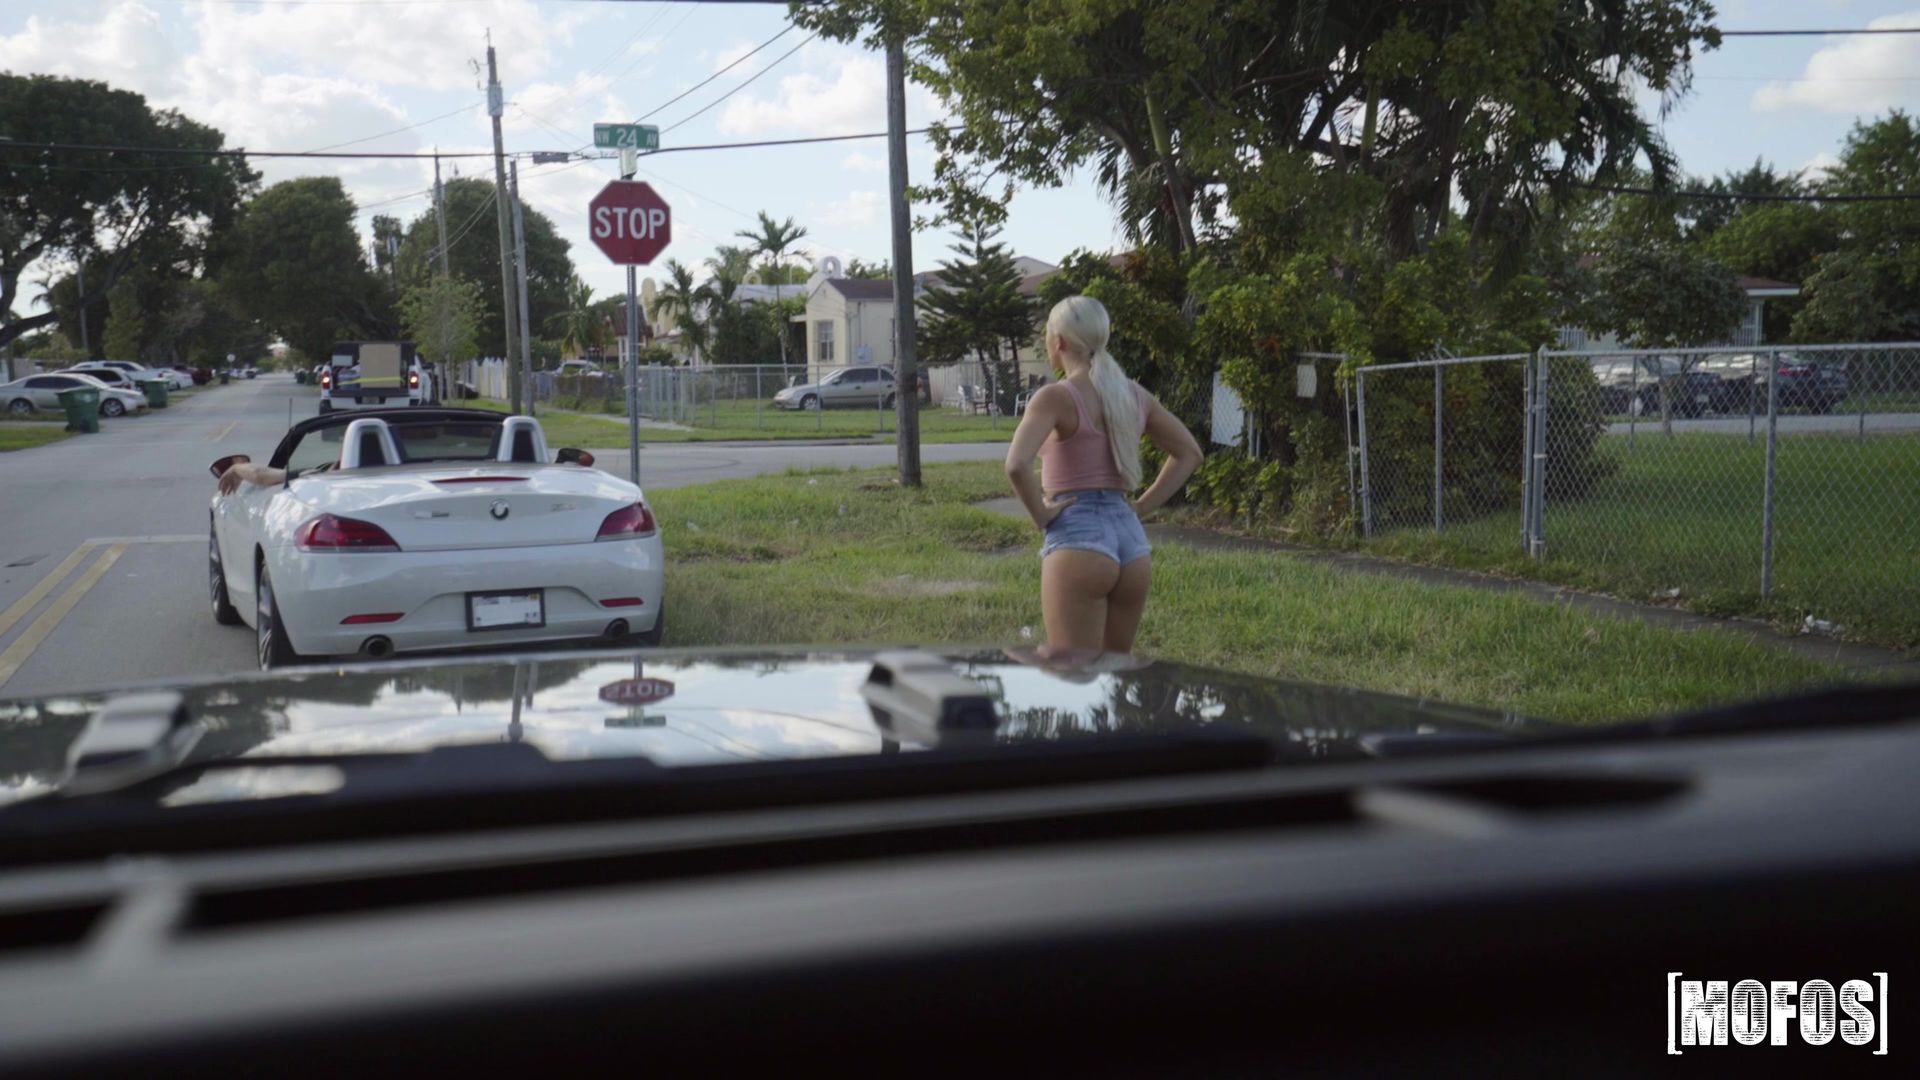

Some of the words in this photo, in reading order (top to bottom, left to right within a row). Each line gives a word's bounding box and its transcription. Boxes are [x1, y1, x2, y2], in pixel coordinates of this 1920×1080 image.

[616, 127, 637, 147] 24
[646, 132, 658, 147] AV
[594, 205, 666, 240] STOP
